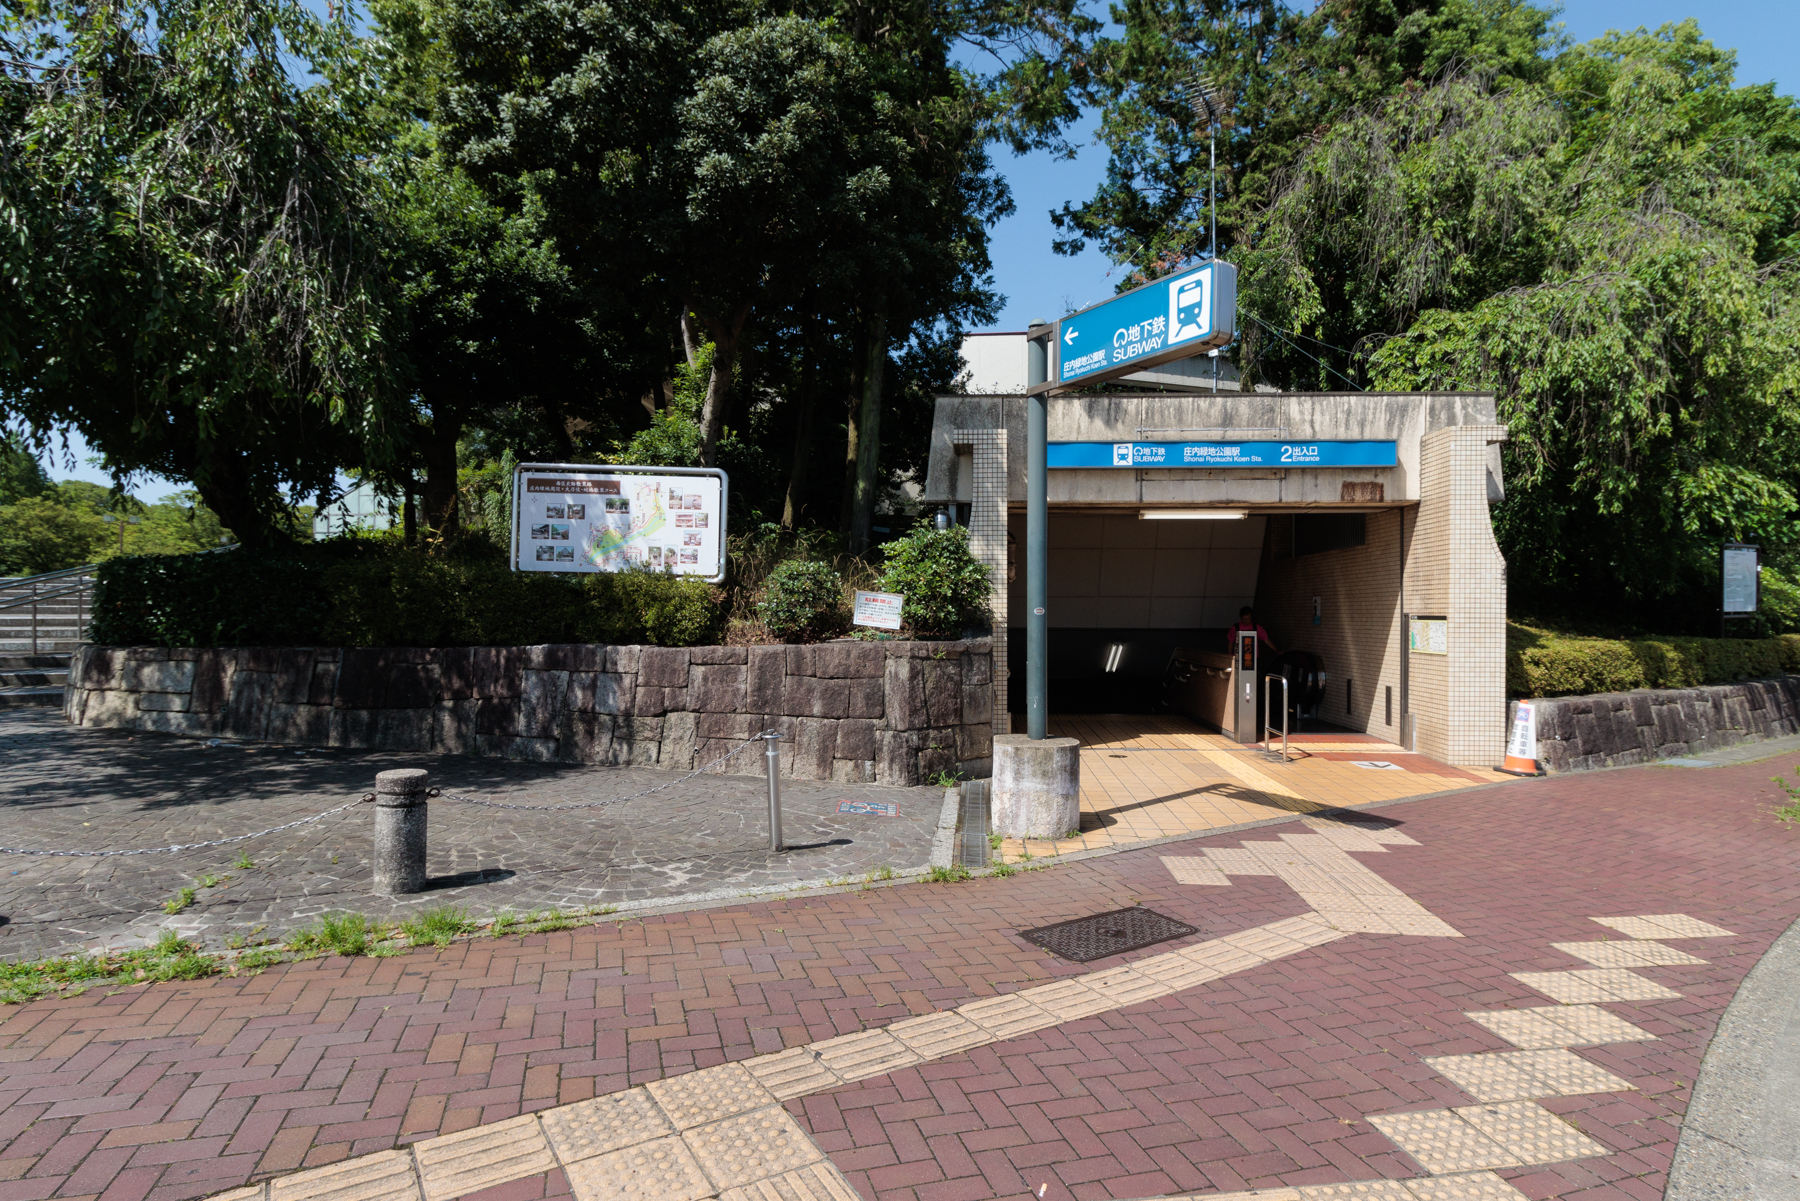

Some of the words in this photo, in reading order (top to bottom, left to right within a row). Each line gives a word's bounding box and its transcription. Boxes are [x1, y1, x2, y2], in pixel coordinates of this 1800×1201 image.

[1128, 314, 1165, 342] 地下鉄
[1113, 334, 1165, 362] SUBWAY
[1064, 349, 1105, 371] 庄内緑地公園駅
[1063, 370, 1075, 378] Shonai
[1075, 365, 1091, 375] Ryokuchi
[1090, 361, 1101, 370] Koen
[1143, 447, 1166, 456] 地下鉄
[1183, 446, 1240, 456] 庄内緑地公園駅
[1281, 445, 1292, 462] 2
[1293, 446, 1318, 456] 出入口
[1206, 456, 1233, 464] Ryokuchi
